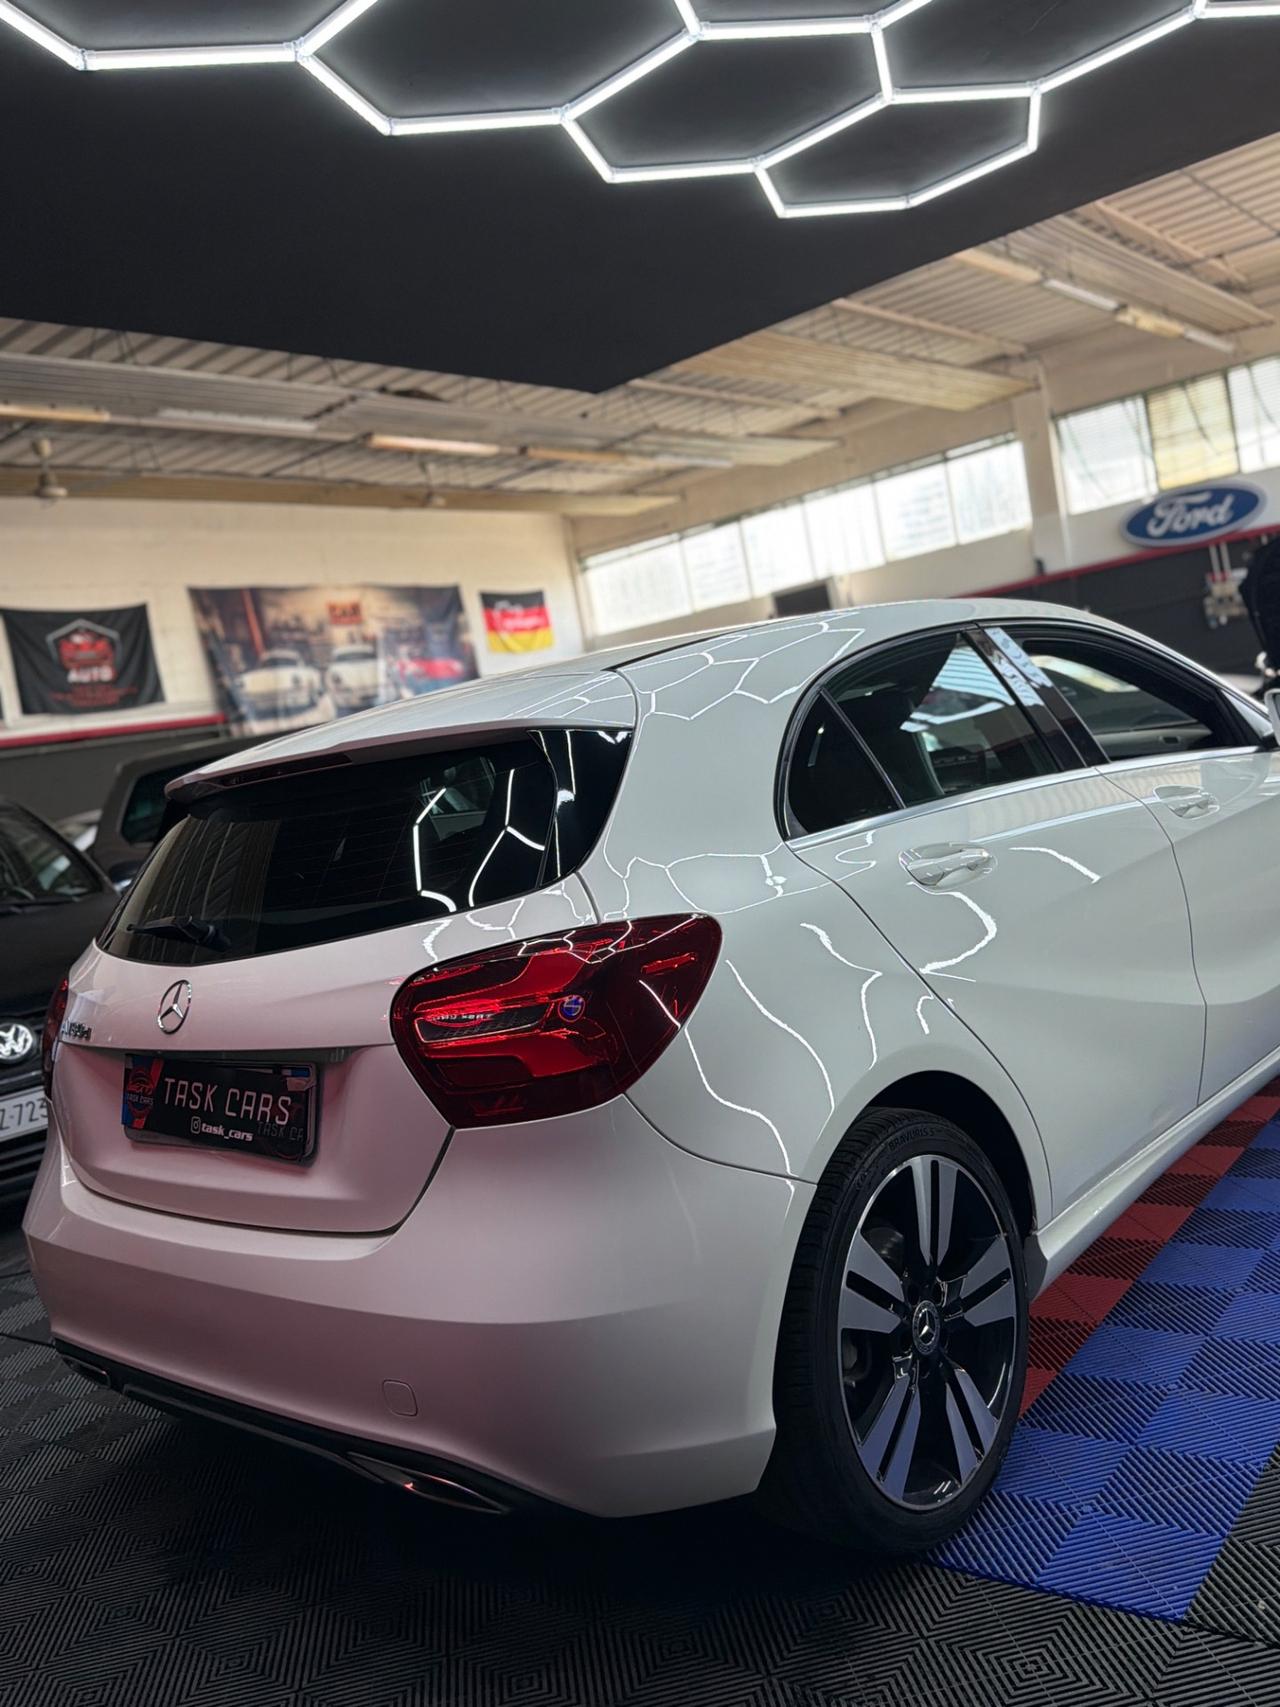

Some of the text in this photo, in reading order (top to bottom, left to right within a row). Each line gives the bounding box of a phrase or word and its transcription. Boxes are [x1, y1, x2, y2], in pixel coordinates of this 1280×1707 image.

[1147, 491, 1234, 537] Ford
[67, 665, 114, 683] AUTO
[163, 1077, 292, 1125] TASK CARS
[201, 1122, 253, 1142] task_cars
